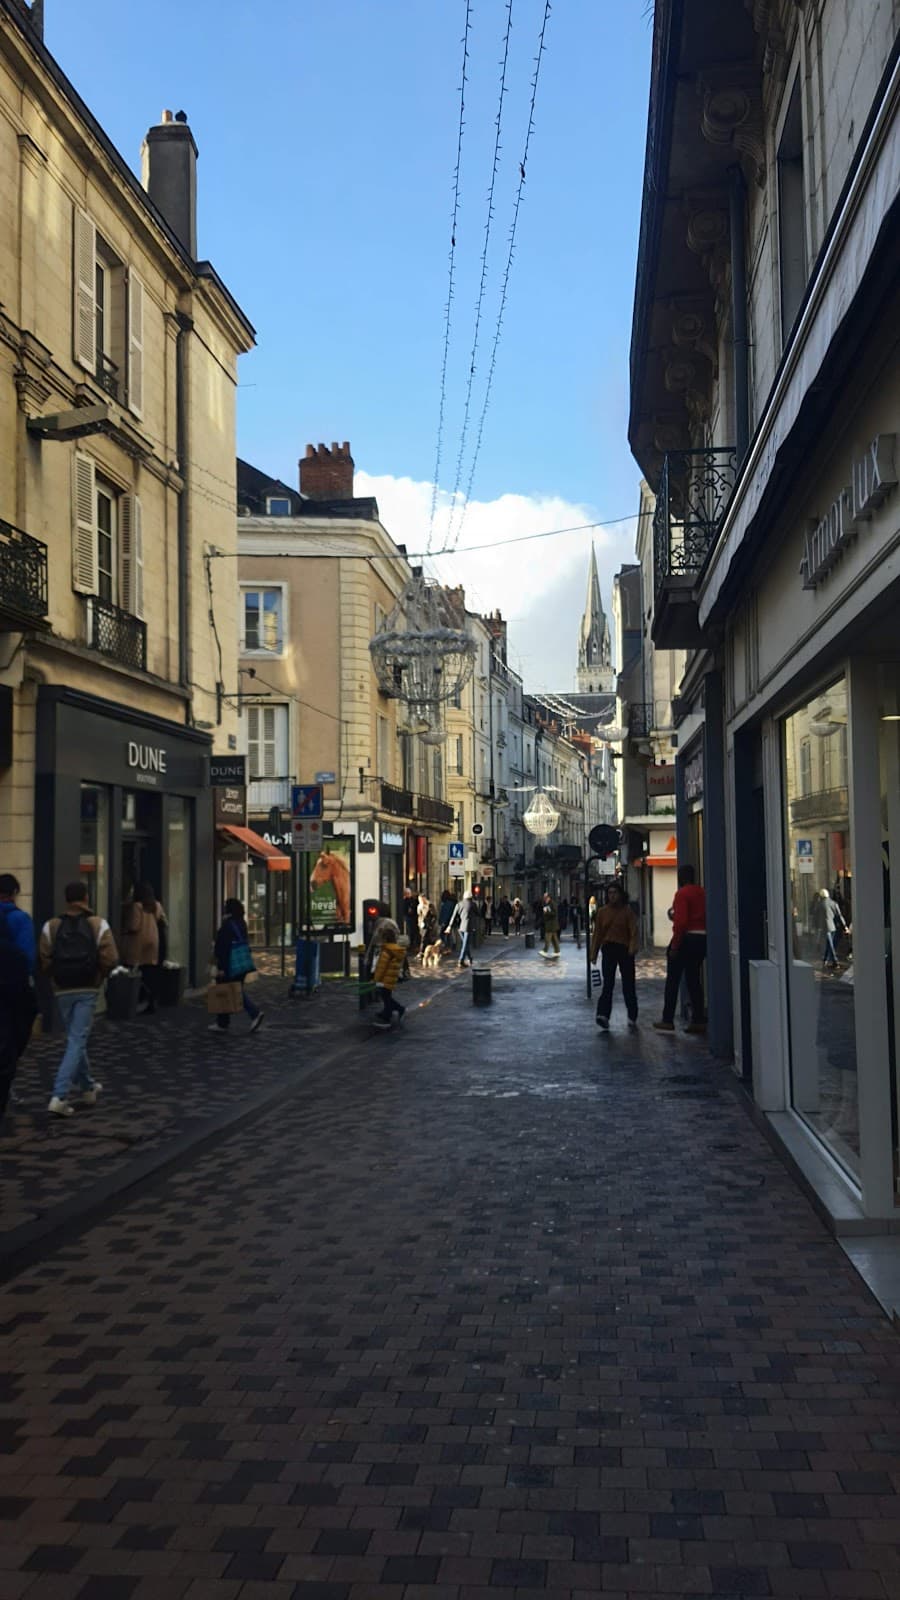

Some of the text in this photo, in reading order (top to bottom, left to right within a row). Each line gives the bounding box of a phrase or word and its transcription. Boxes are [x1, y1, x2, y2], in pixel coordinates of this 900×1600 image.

[128, 741, 167, 774] DUNE
[210, 767, 244, 777] DUNE
[311, 899, 337, 911] heval
